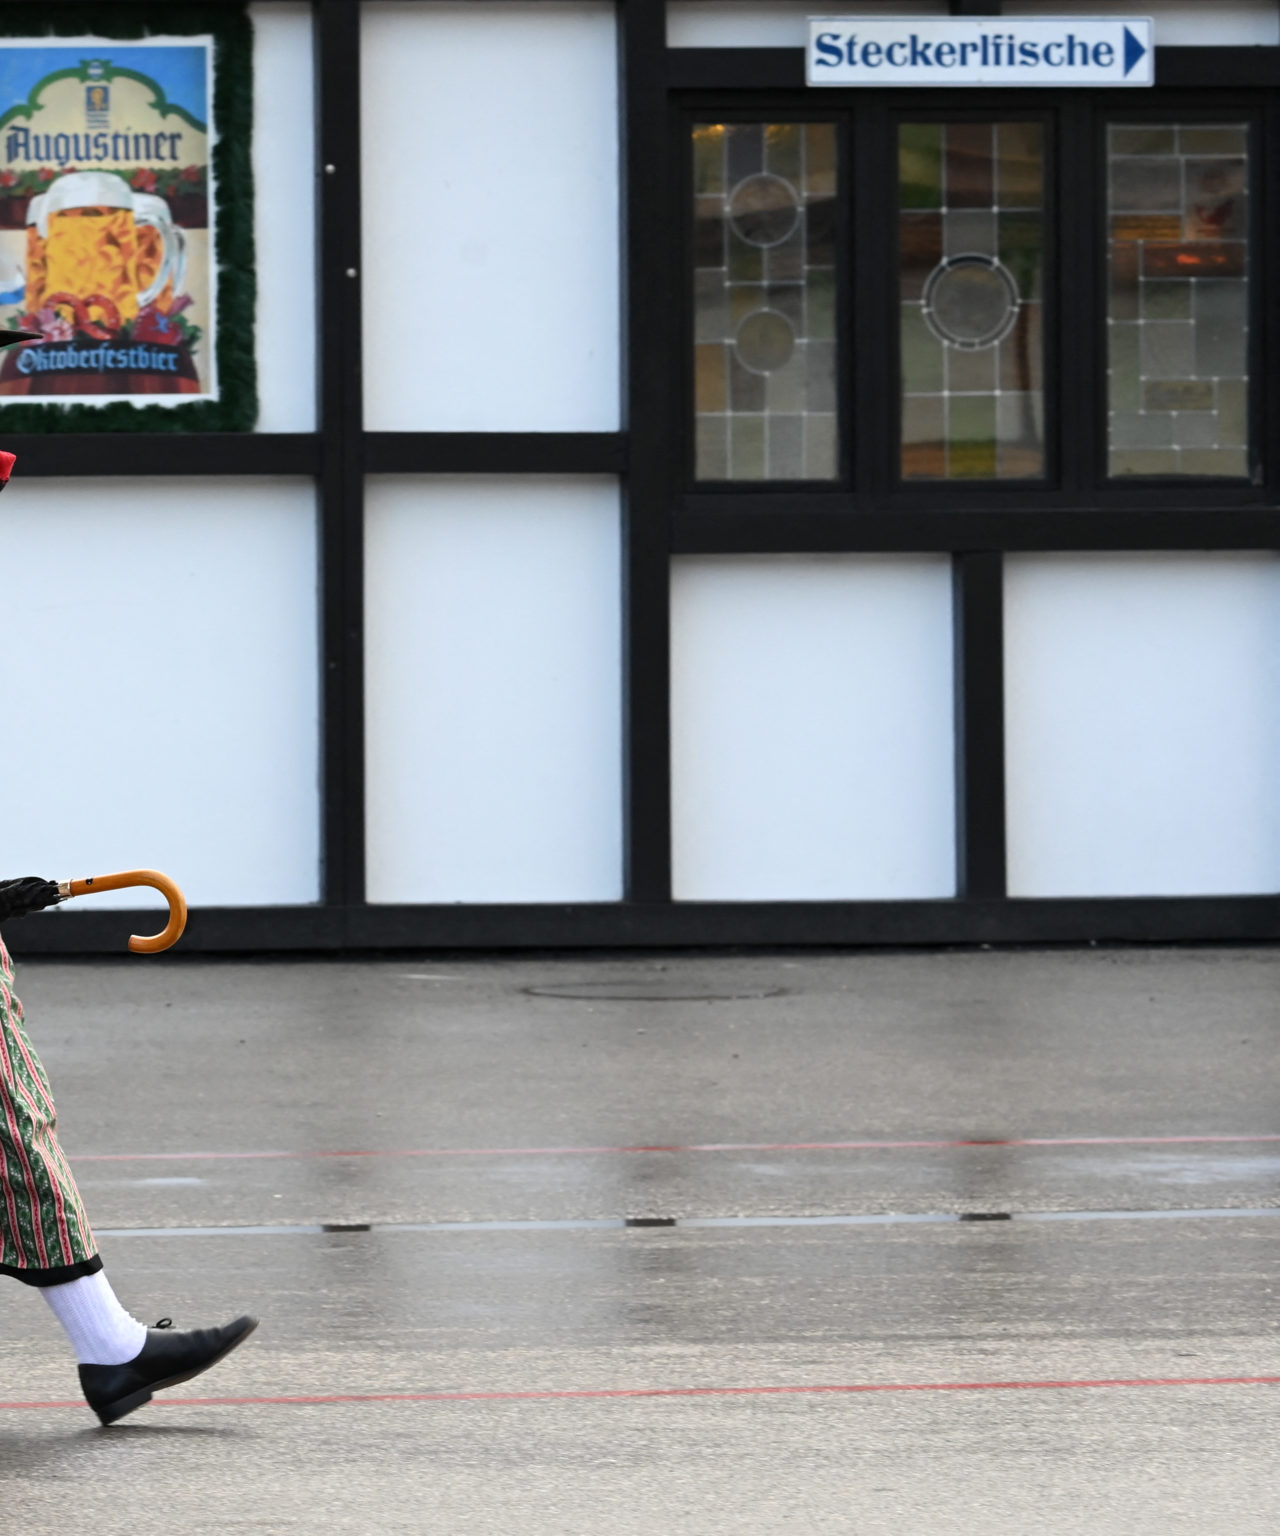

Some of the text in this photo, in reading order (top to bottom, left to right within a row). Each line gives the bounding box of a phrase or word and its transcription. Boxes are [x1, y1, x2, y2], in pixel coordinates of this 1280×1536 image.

[815, 32, 1114, 67] Steckerlfische
[6, 125, 183, 166] Augustiner
[17, 342, 179, 374] Oktoberfestbier
